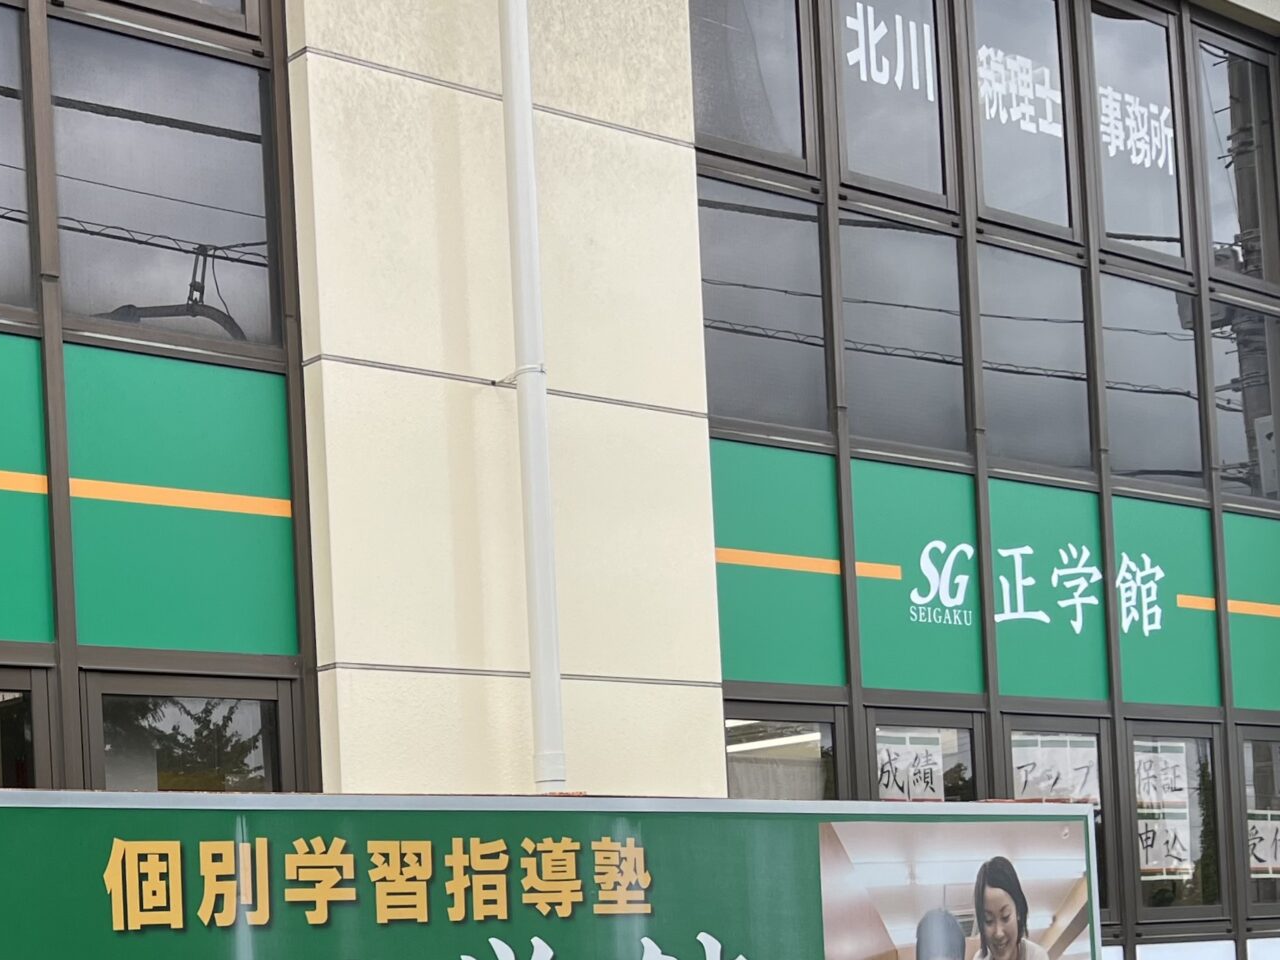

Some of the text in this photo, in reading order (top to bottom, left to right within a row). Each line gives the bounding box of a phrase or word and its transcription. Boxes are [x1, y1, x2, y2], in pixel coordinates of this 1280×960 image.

[846, 2, 1175, 175] 北川 税理士 事務所
[910, 540, 975, 608] SG
[994, 543, 1165, 638] 正学館
[909, 606, 973, 627] SEIGAKU
[877, 747, 1184, 796] 成績 アップ 保証
[1139, 823, 1188, 864] 申込
[103, 837, 653, 931] 個別学習指導塾
